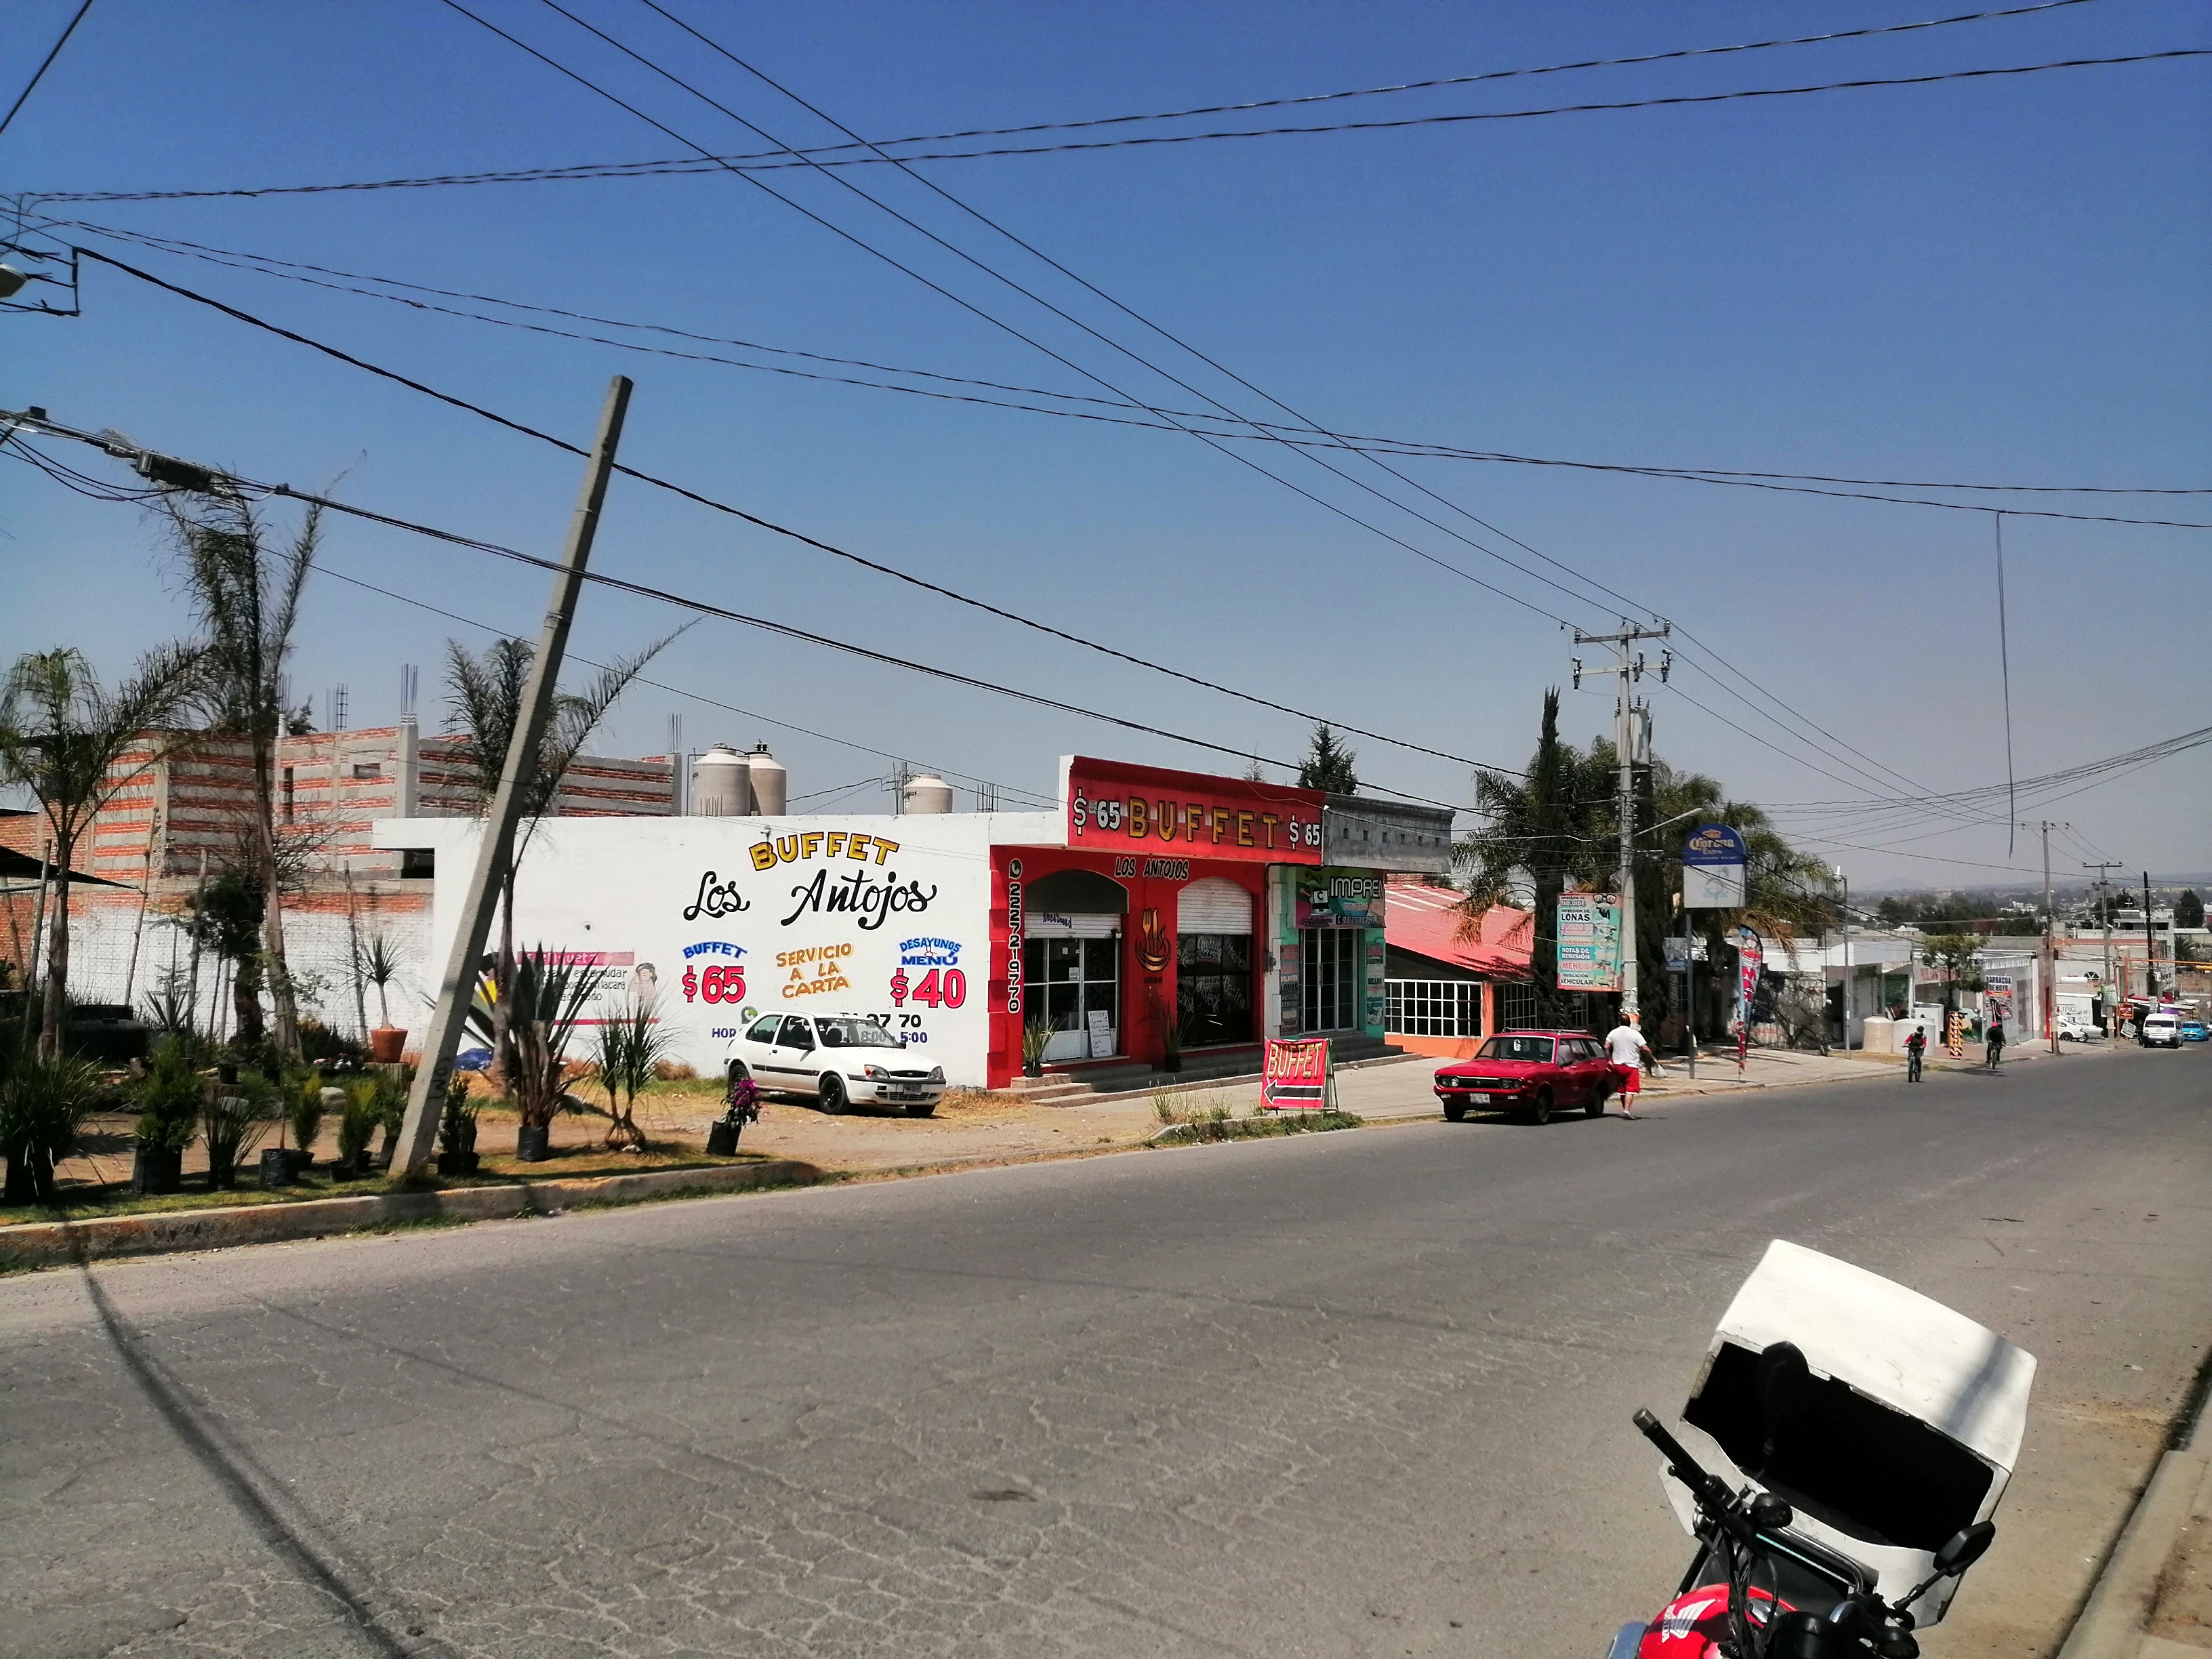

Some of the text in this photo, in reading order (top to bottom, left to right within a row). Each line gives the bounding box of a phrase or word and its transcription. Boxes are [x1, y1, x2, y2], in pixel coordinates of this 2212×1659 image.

[1097, 800, 1121, 830] 65
[1128, 796, 1278, 849] BUFFET
[1305, 823, 1320, 846] 65
[748, 832, 900, 872] BUFFET
[1689, 837, 1734, 851] Corona
[1115, 857, 1189, 880] LOS ANTOJOS
[683, 869, 937, 930] Los Antojos
[1561, 914, 1591, 922] LONAS
[683, 941, 747, 960] BUFFET
[776, 943, 854, 968] SERVICIO
[899, 937, 962, 958] DESAYUNOS
[790, 962, 841, 982] A LA
[782, 975, 851, 1000] CARTA
[899, 1014, 922, 1028] 70
[900, 1031, 928, 1043] 5:00
[1267, 1042, 1323, 1079] BUFFET
